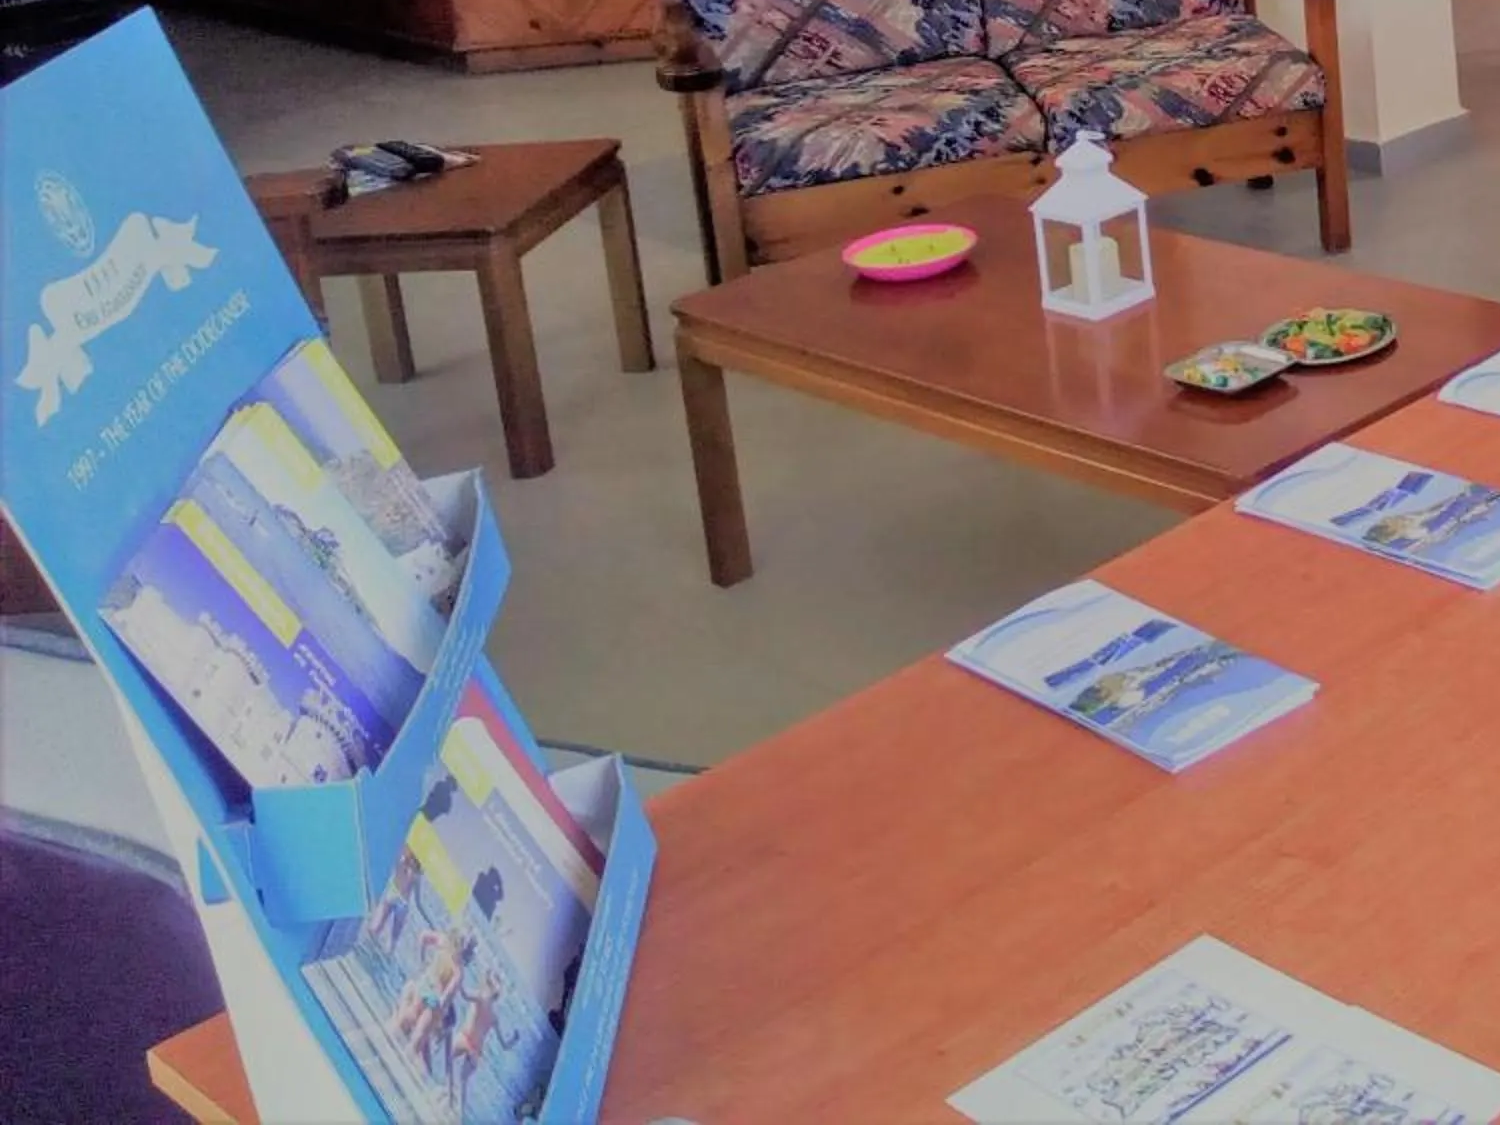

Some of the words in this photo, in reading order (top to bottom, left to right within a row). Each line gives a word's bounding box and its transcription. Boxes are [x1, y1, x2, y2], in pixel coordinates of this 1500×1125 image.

[100, 416, 131, 450] THE
[146, 373, 168, 402] OF
[160, 352, 189, 384] THE
